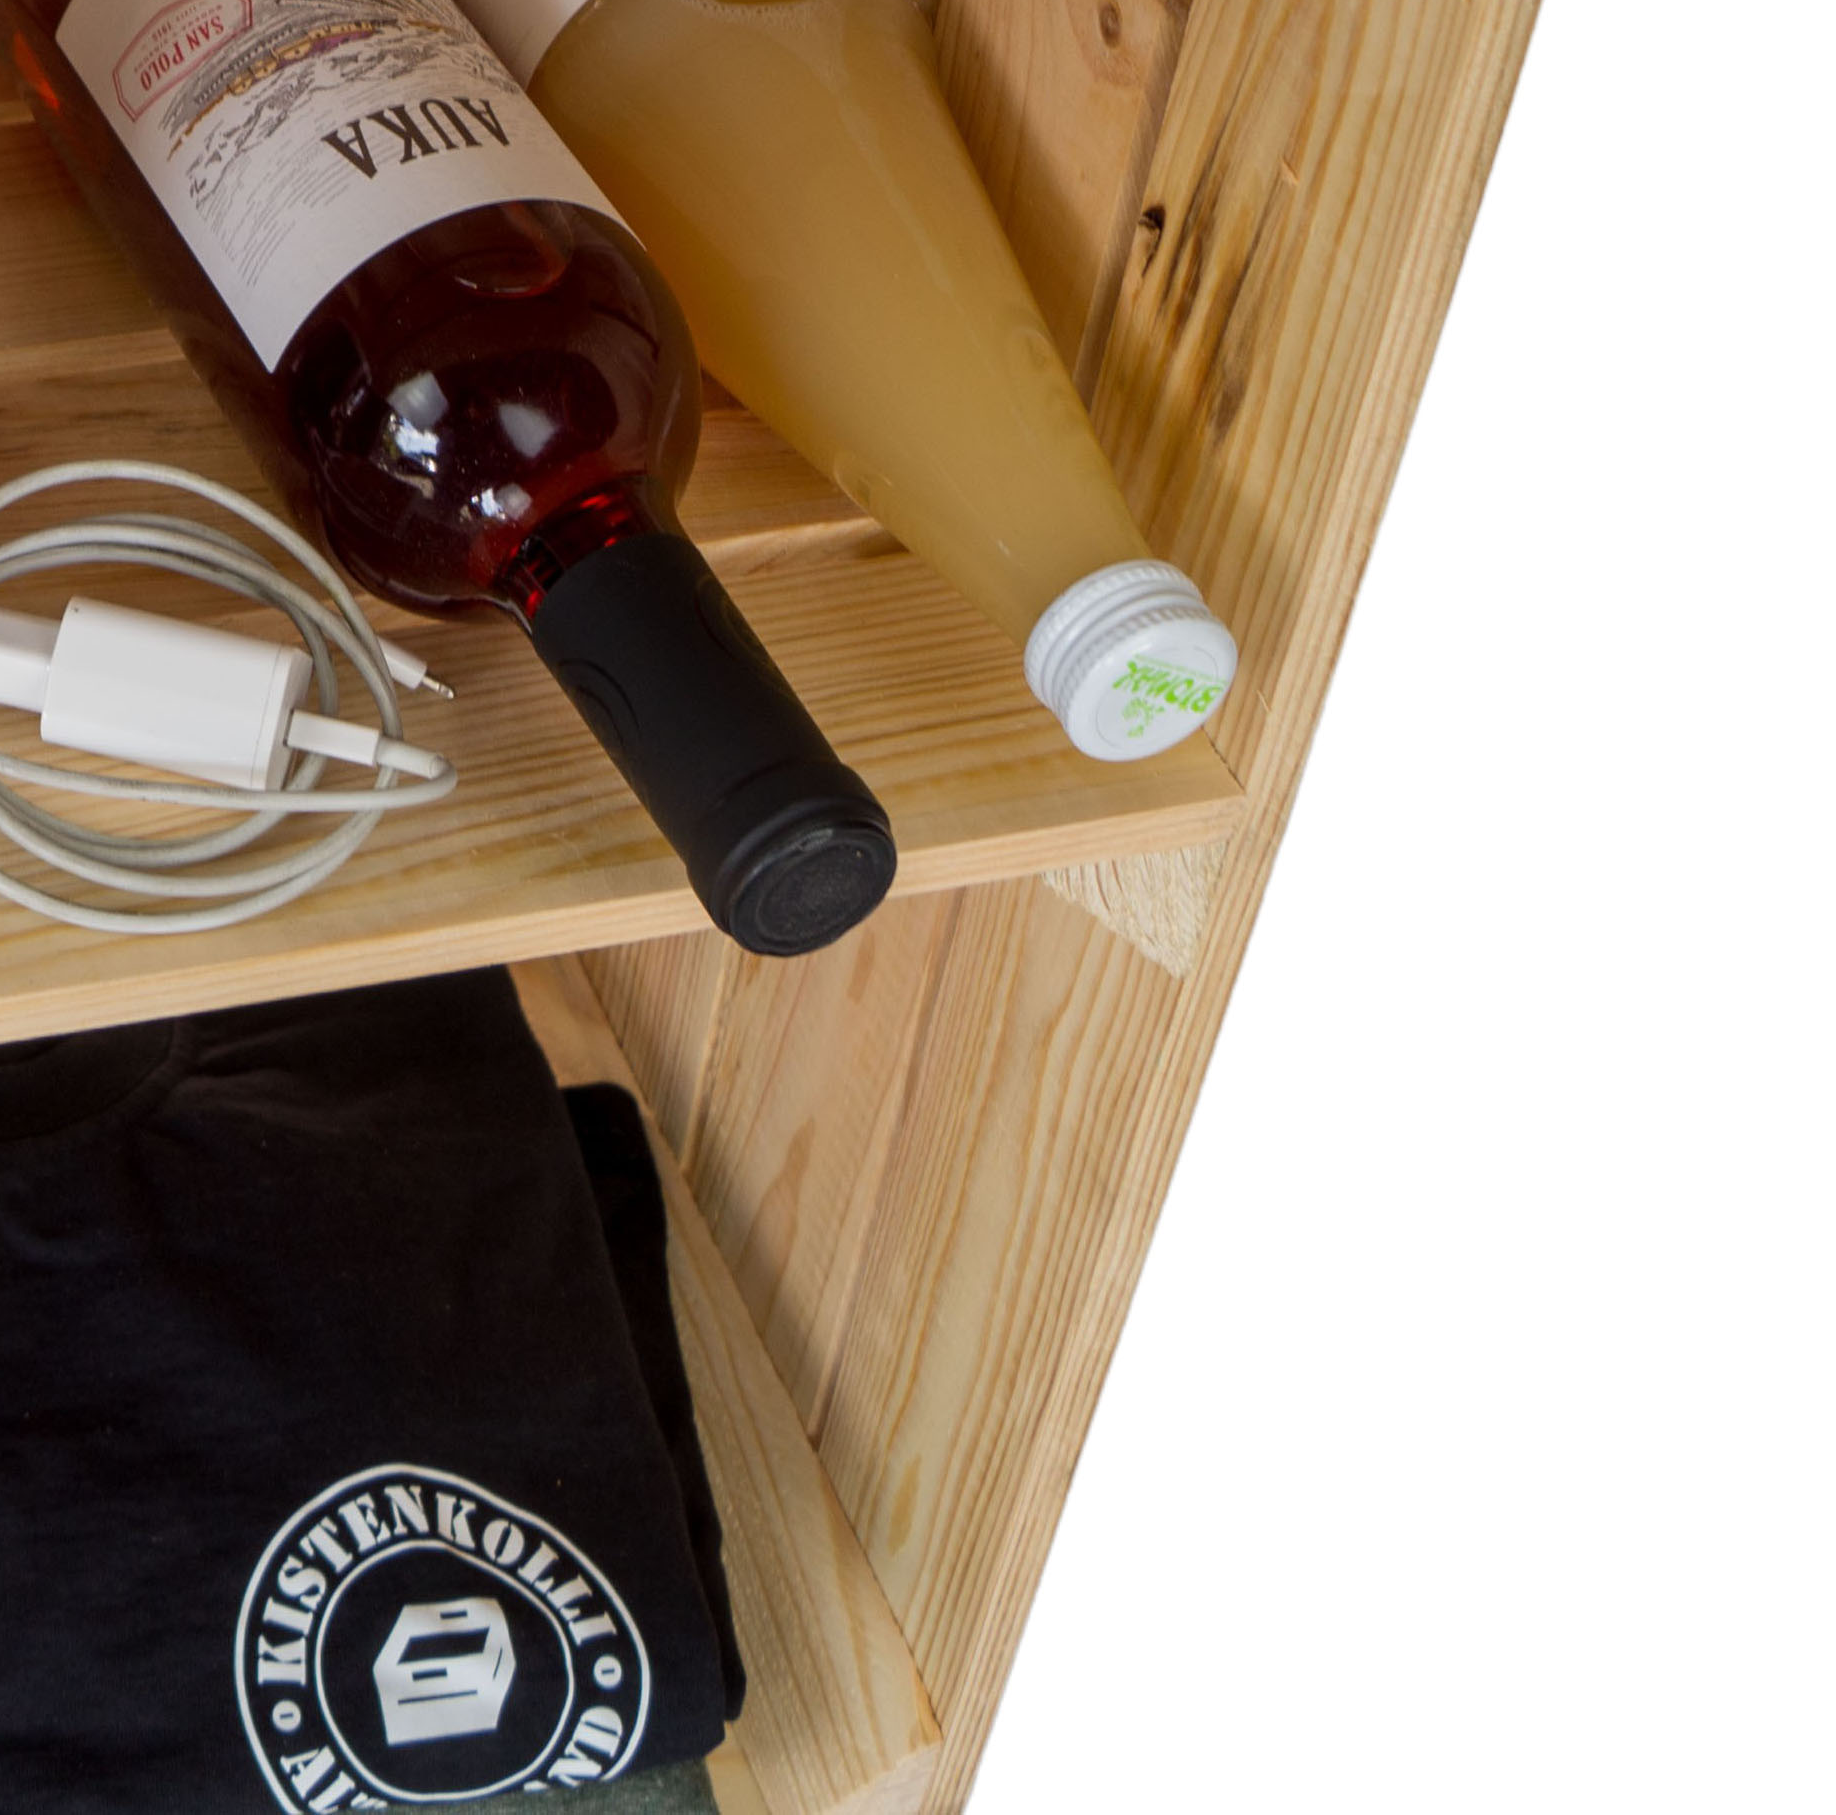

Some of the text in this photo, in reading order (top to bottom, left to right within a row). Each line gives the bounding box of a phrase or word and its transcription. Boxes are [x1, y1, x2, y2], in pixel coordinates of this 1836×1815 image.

[139, 41, 185, 91] POLO
[185, 15, 225, 51] SAN
[322, 97, 511, 179] AUKA
[257, 1485, 617, 1686] KISTENKOLLI
